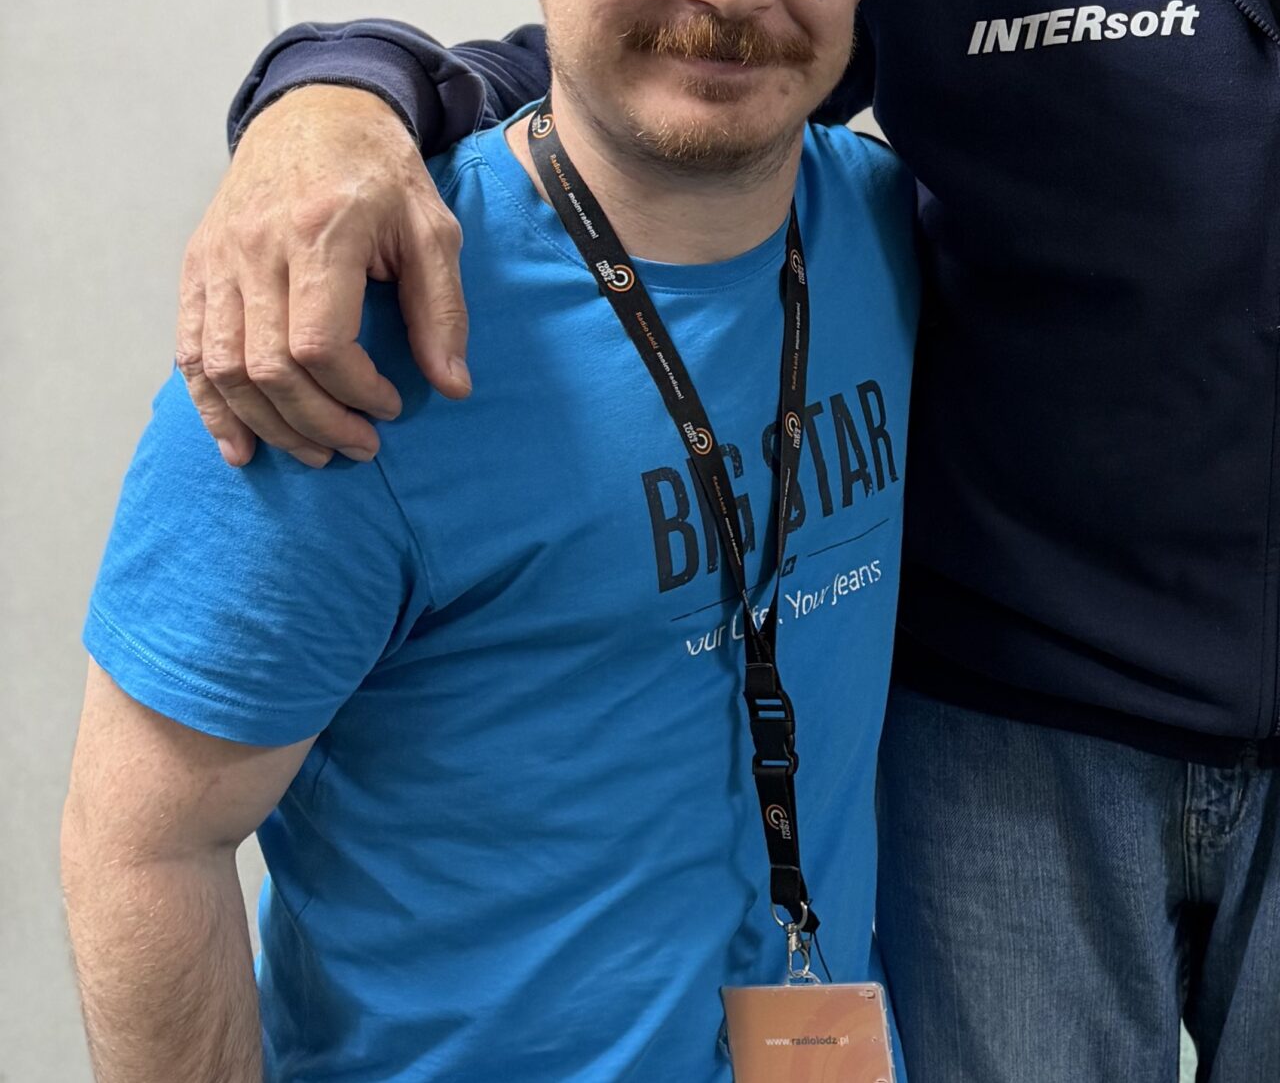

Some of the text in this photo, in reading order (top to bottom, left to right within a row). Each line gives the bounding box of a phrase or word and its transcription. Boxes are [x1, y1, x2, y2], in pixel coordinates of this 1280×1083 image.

[967, 0, 1199, 55] INTERsoft
[831, 560, 882, 605] Jeans
[765, 1035, 849, 1047] www.radiolodz.pl
